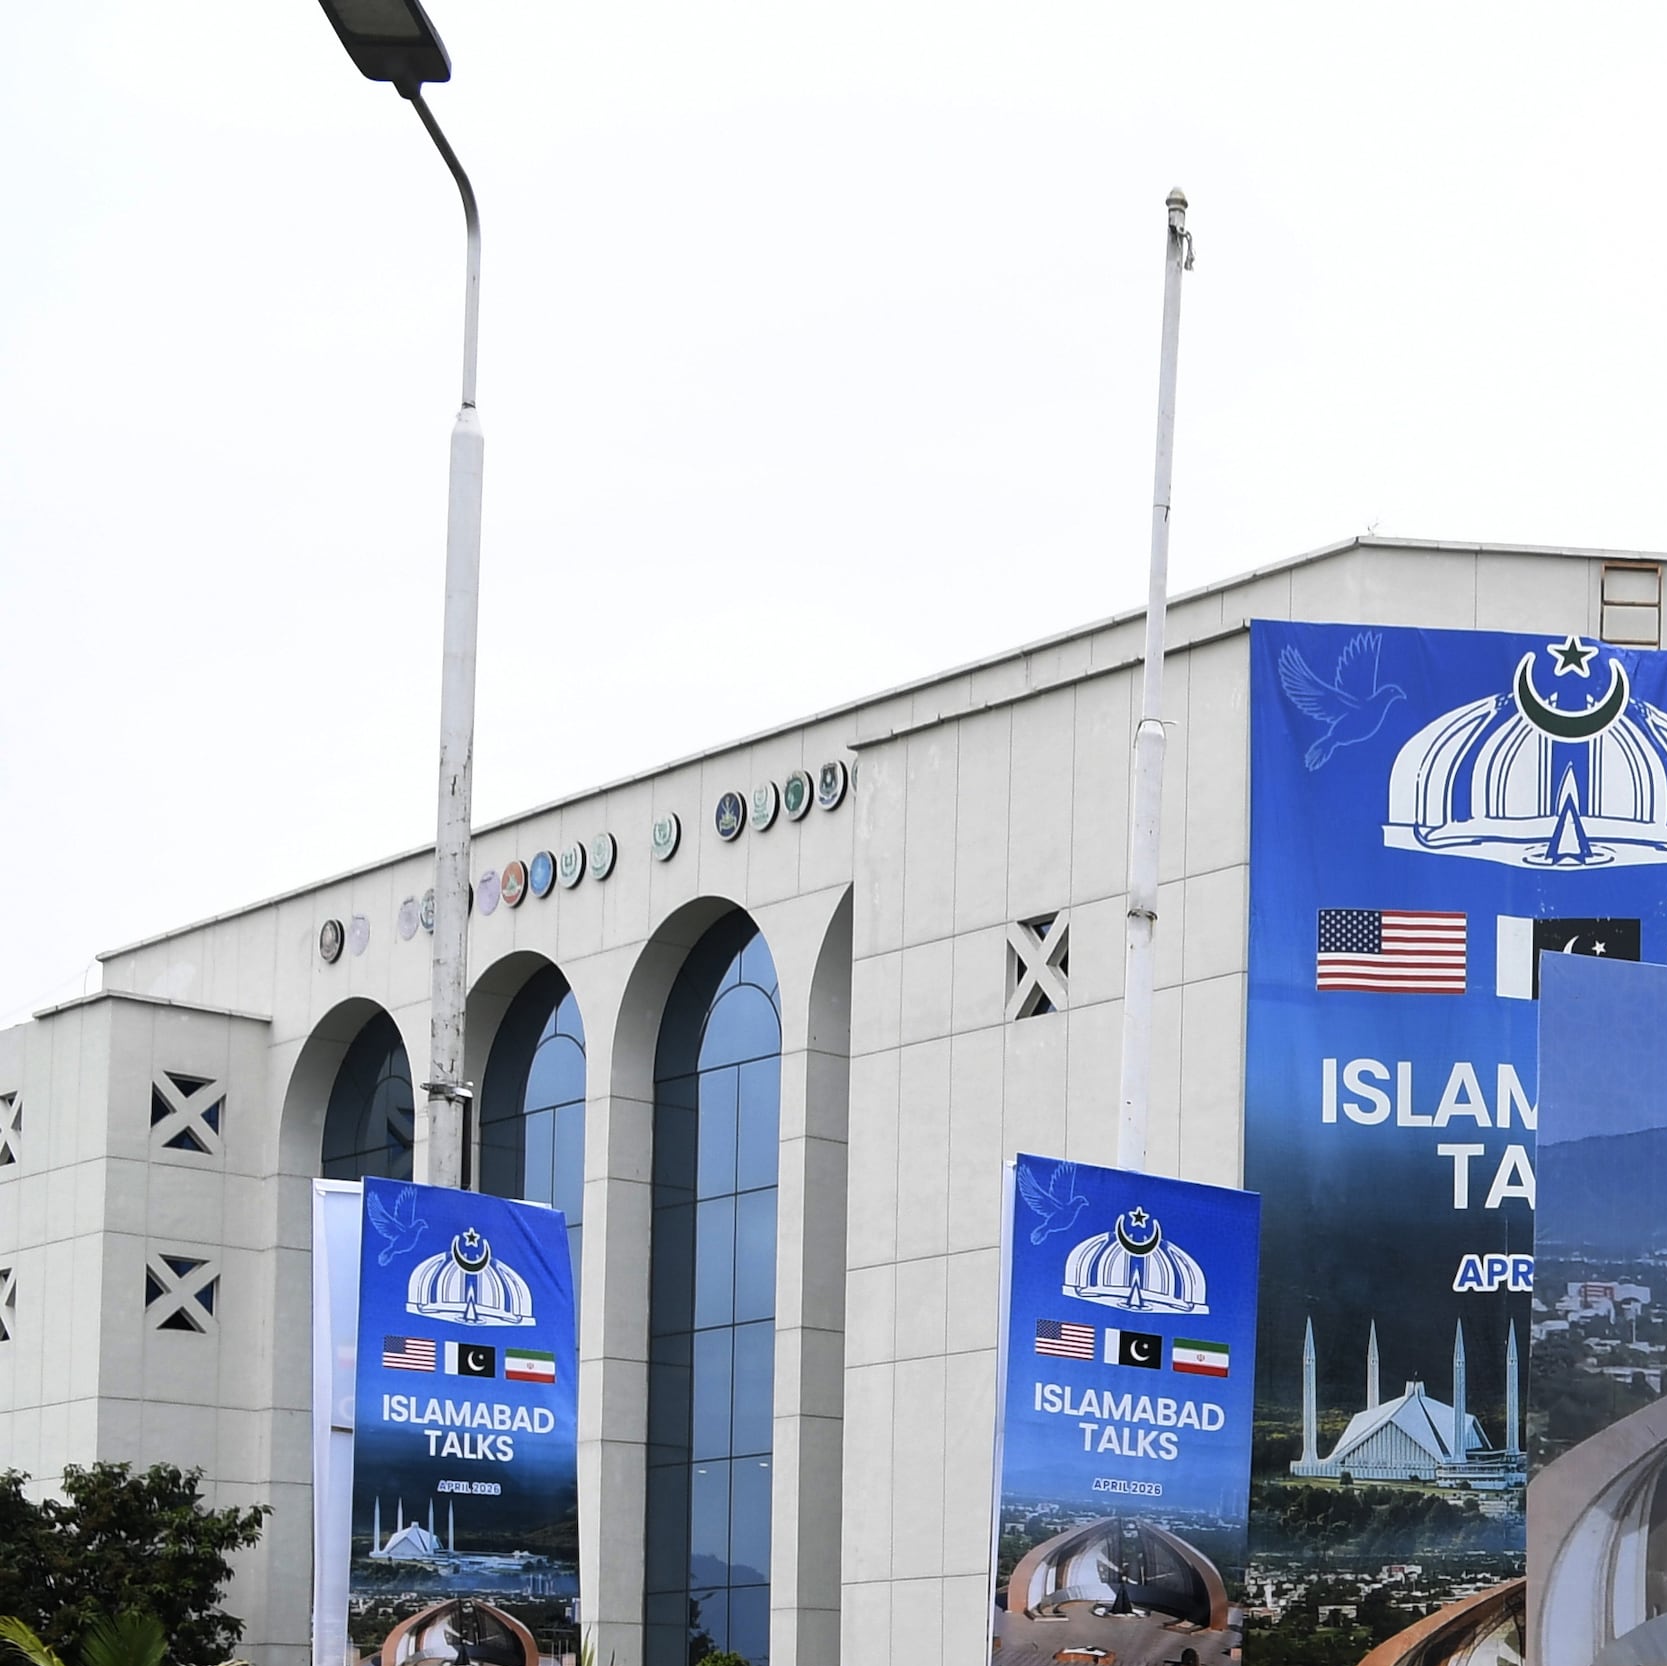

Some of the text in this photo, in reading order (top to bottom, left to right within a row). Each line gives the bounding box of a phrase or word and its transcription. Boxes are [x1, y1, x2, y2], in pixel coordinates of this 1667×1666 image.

[382, 1393, 555, 1434] ISLAMABAD
[1034, 1382, 1225, 1431] ISLAMABAD
[424, 1429, 514, 1462] TALKS
[1079, 1422, 1178, 1460] TALKS
[437, 1480, 501, 1495] APRIL 2026
[1092, 1478, 1162, 1496] APRIL 2026
